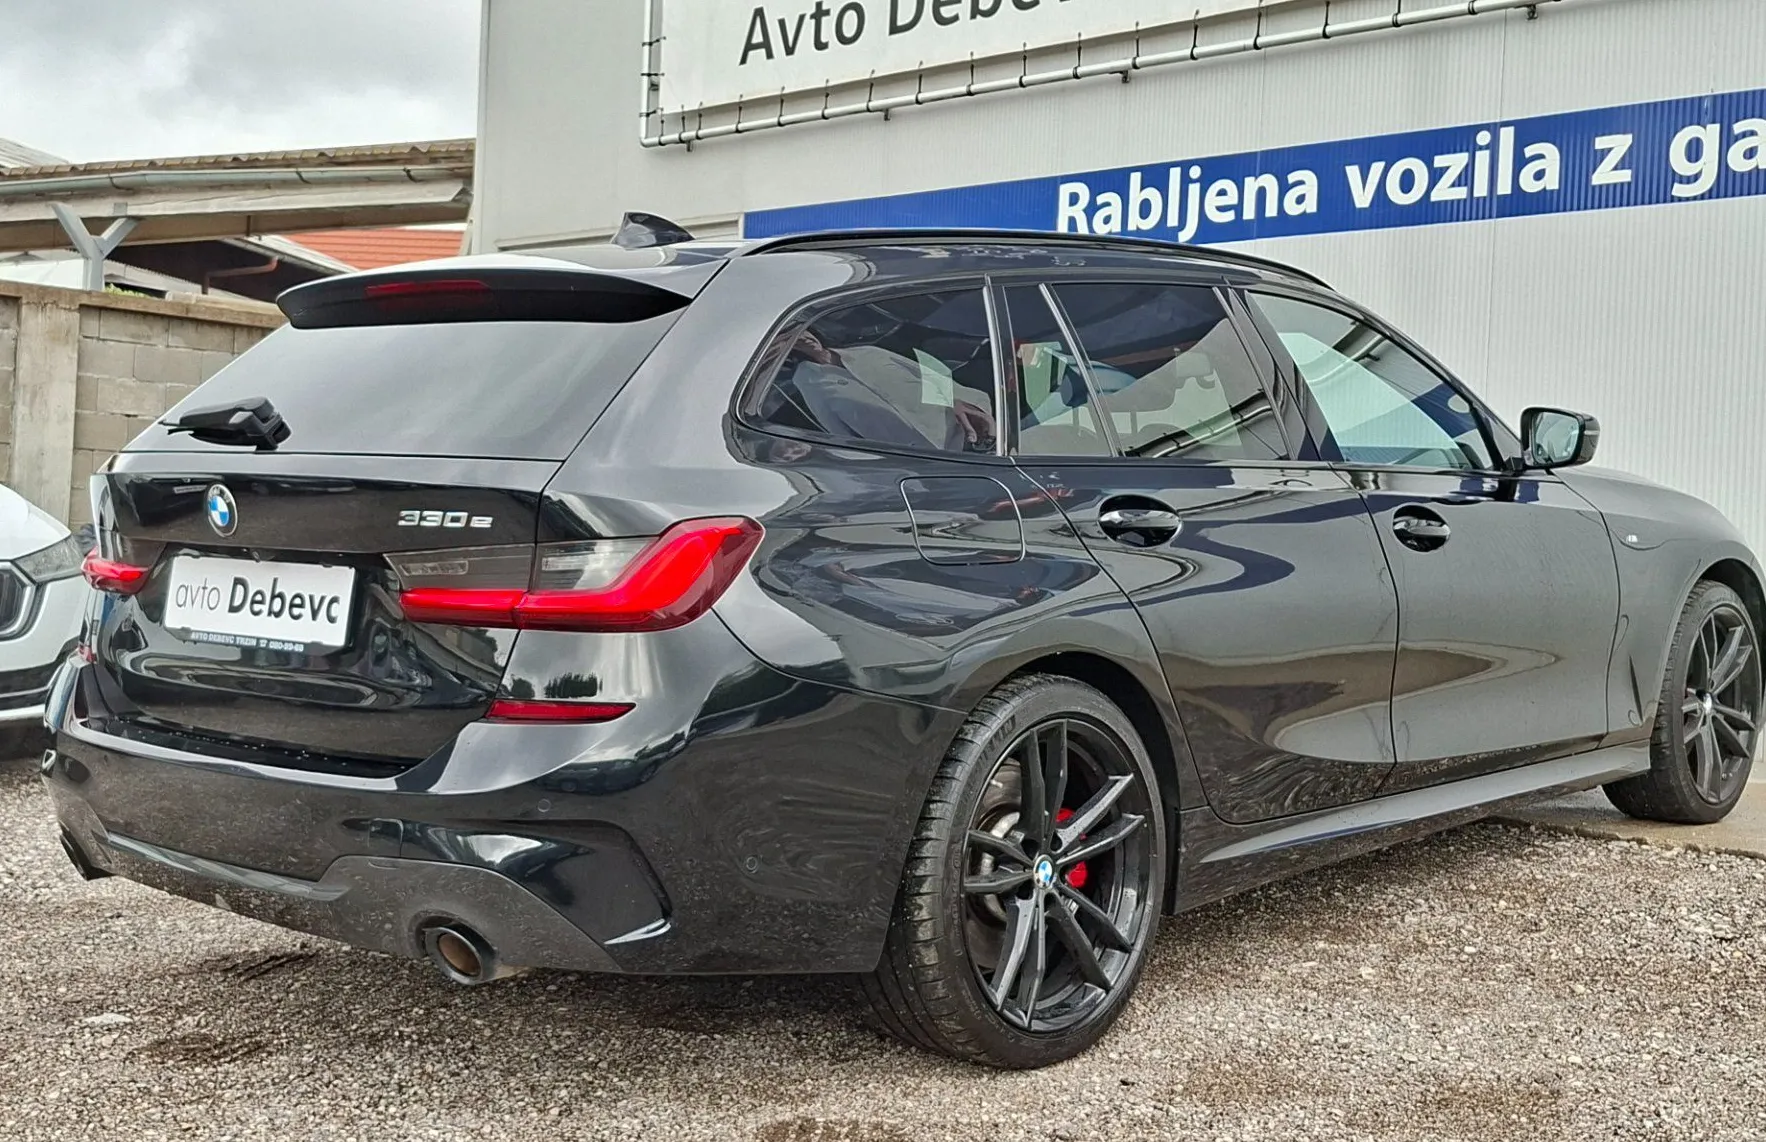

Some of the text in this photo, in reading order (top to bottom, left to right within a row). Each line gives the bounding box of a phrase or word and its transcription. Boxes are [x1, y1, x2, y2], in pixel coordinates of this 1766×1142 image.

[738, 0, 866, 66] Avto
[1057, 164, 1319, 243] Rabljena
[1344, 125, 1560, 209] vozila
[1591, 133, 1633, 186] z
[175, 576, 341, 624] avto Debevc
[190, 631, 208, 641] AVTO
